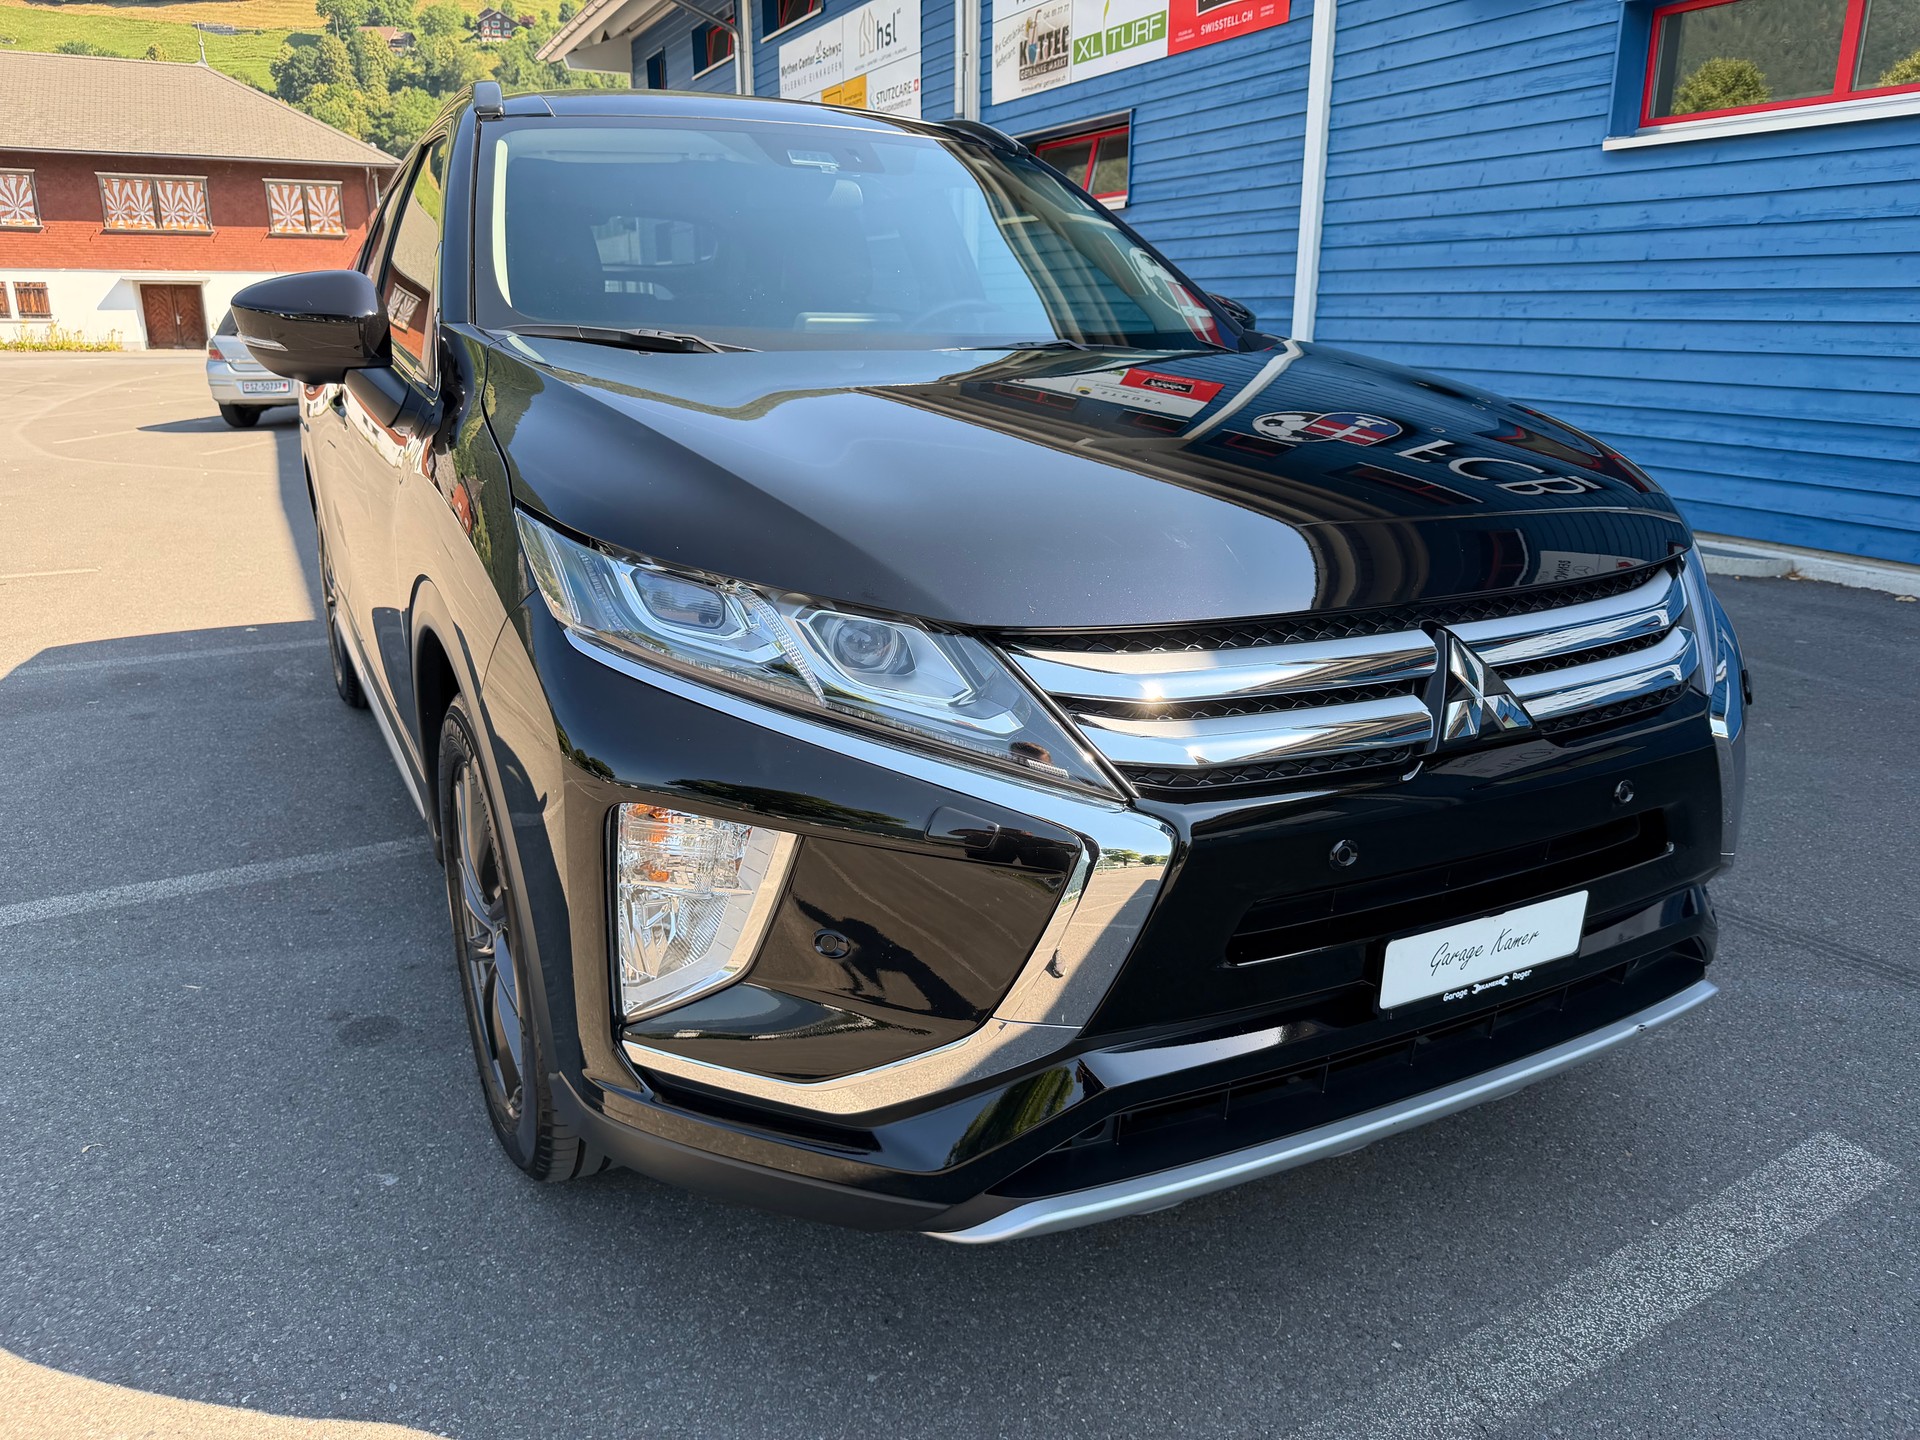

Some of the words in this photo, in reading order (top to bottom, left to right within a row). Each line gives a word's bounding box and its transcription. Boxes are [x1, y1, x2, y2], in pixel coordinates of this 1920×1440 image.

[877, 12, 897, 50] hsl
[1077, 36, 1101, 61] XL
[1108, 14, 1162, 51] TURF
[1200, 10, 1254, 36] SWISSTELL.CH
[822, 42, 842, 59] Schwyz
[1430, 941, 1484, 977] Garage
[1490, 928, 1540, 956] Kamer
[1442, 988, 1468, 1002] Garage
[1512, 969, 1532, 981] Roger
